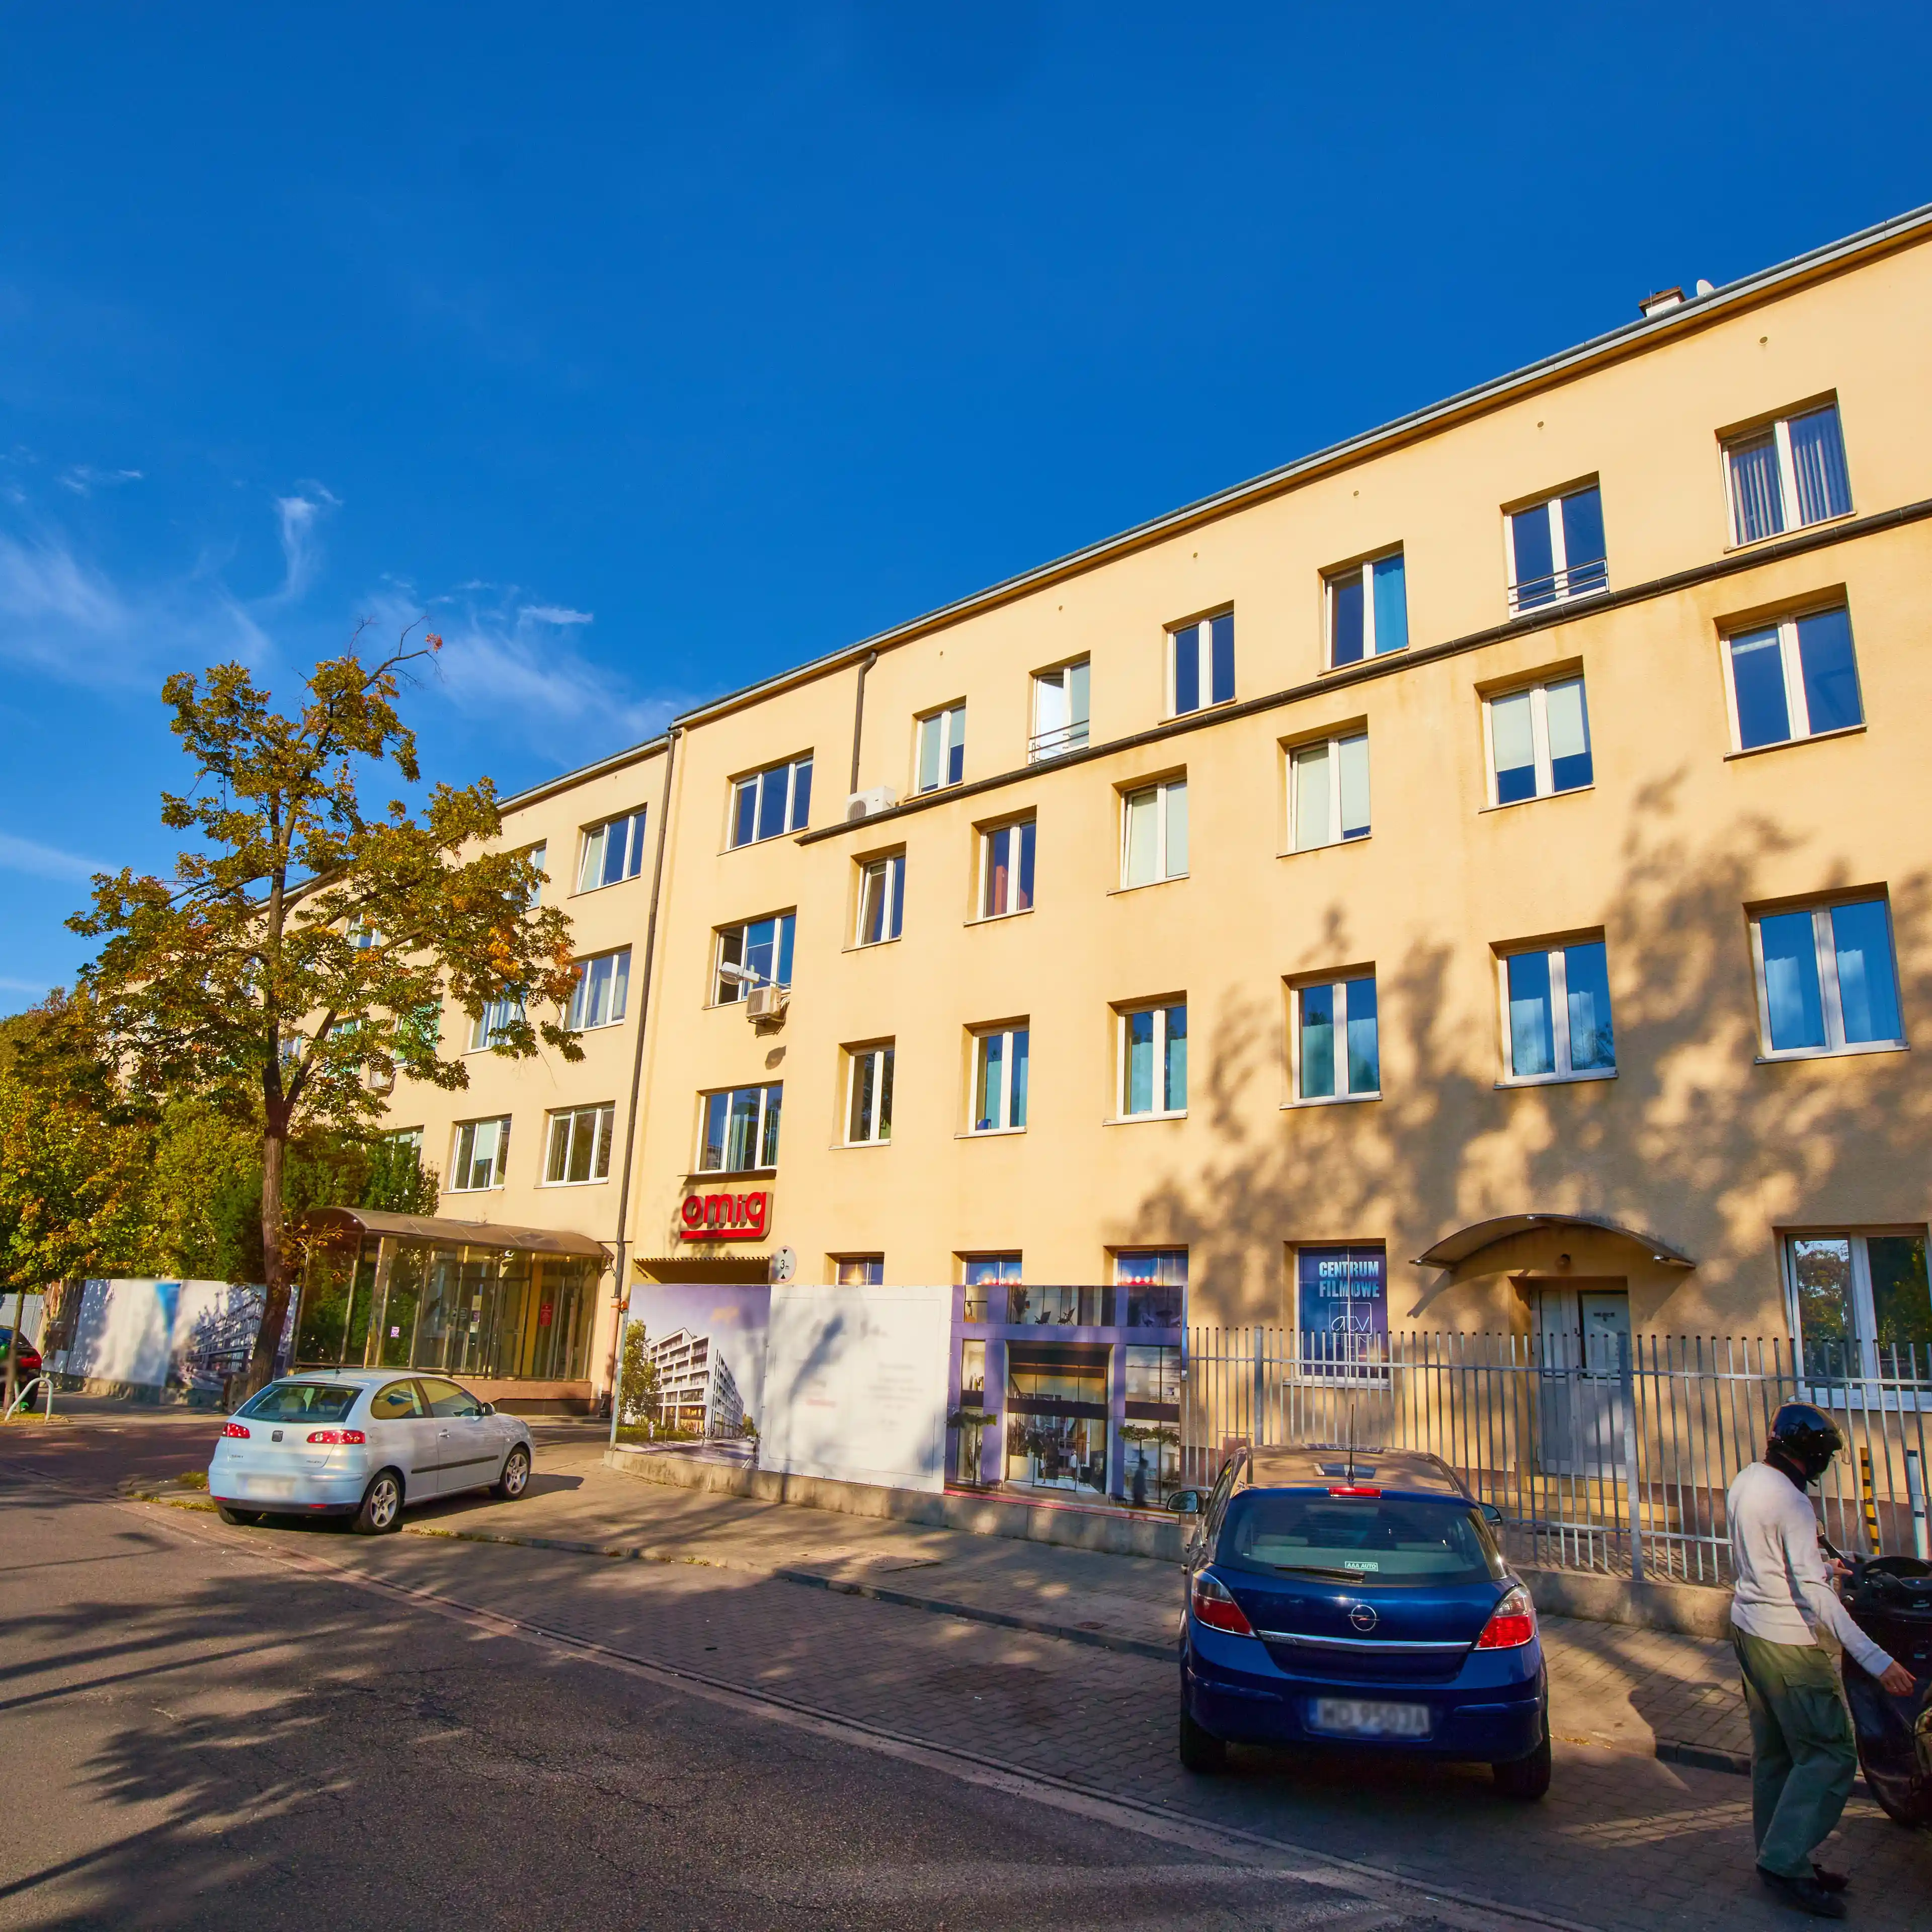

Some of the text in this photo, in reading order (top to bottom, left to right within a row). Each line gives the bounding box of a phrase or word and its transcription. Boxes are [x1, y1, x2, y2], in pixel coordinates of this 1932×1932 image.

[680, 1191, 770, 1239] omig
[1319, 1261, 1379, 1277] CENTRUM
[1319, 1280, 1380, 1297] FILMOWE
